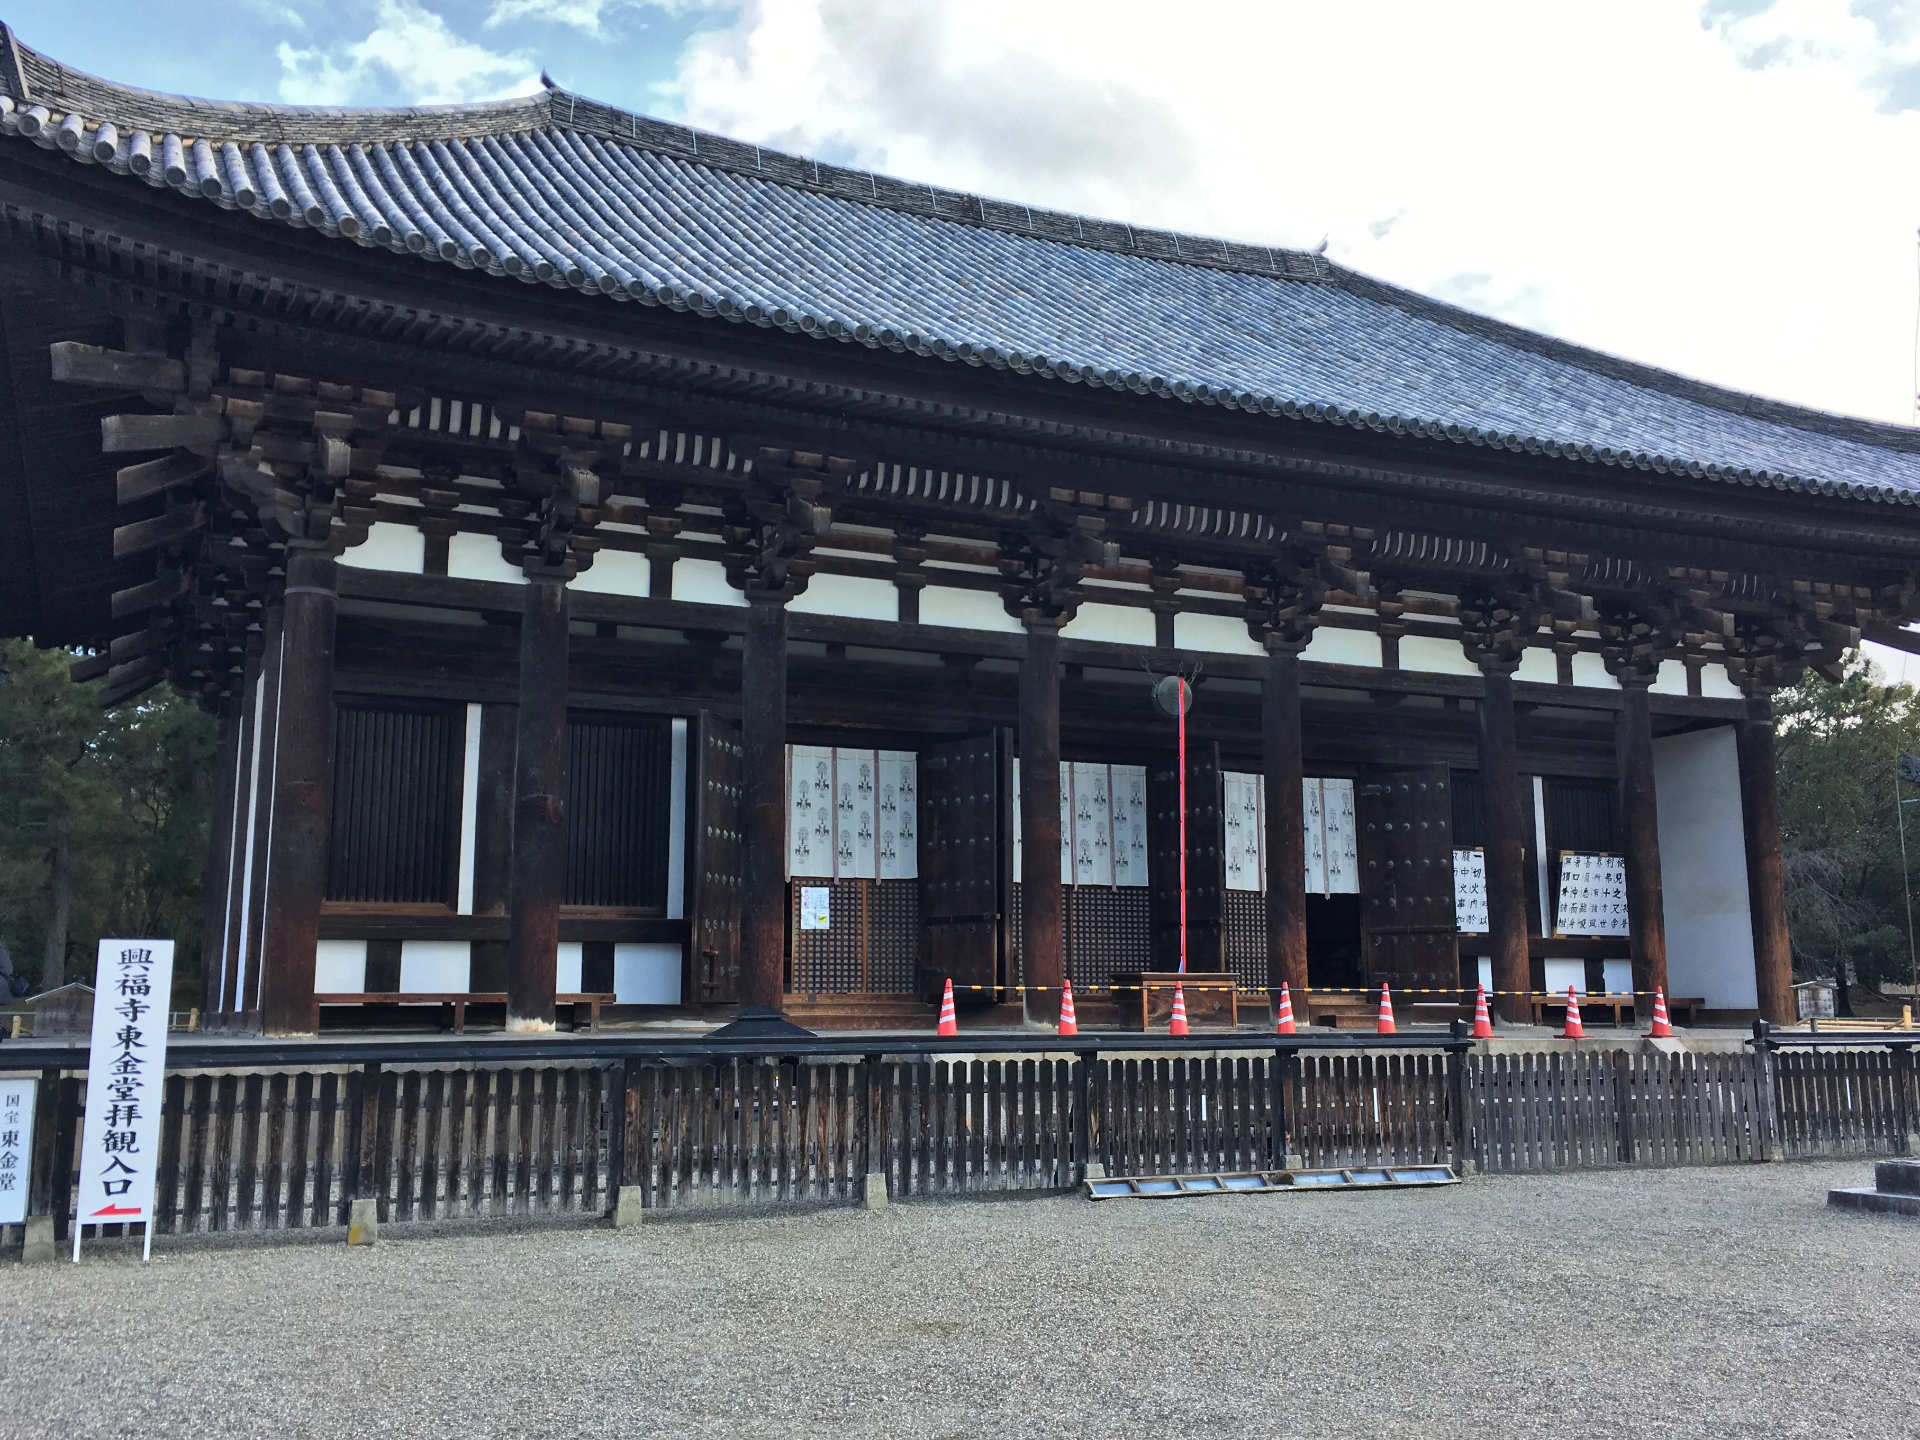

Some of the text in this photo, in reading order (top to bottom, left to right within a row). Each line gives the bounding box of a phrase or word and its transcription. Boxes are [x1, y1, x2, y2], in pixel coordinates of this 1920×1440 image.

[98, 947, 154, 1197] 興福寺東金堂拝観入口
